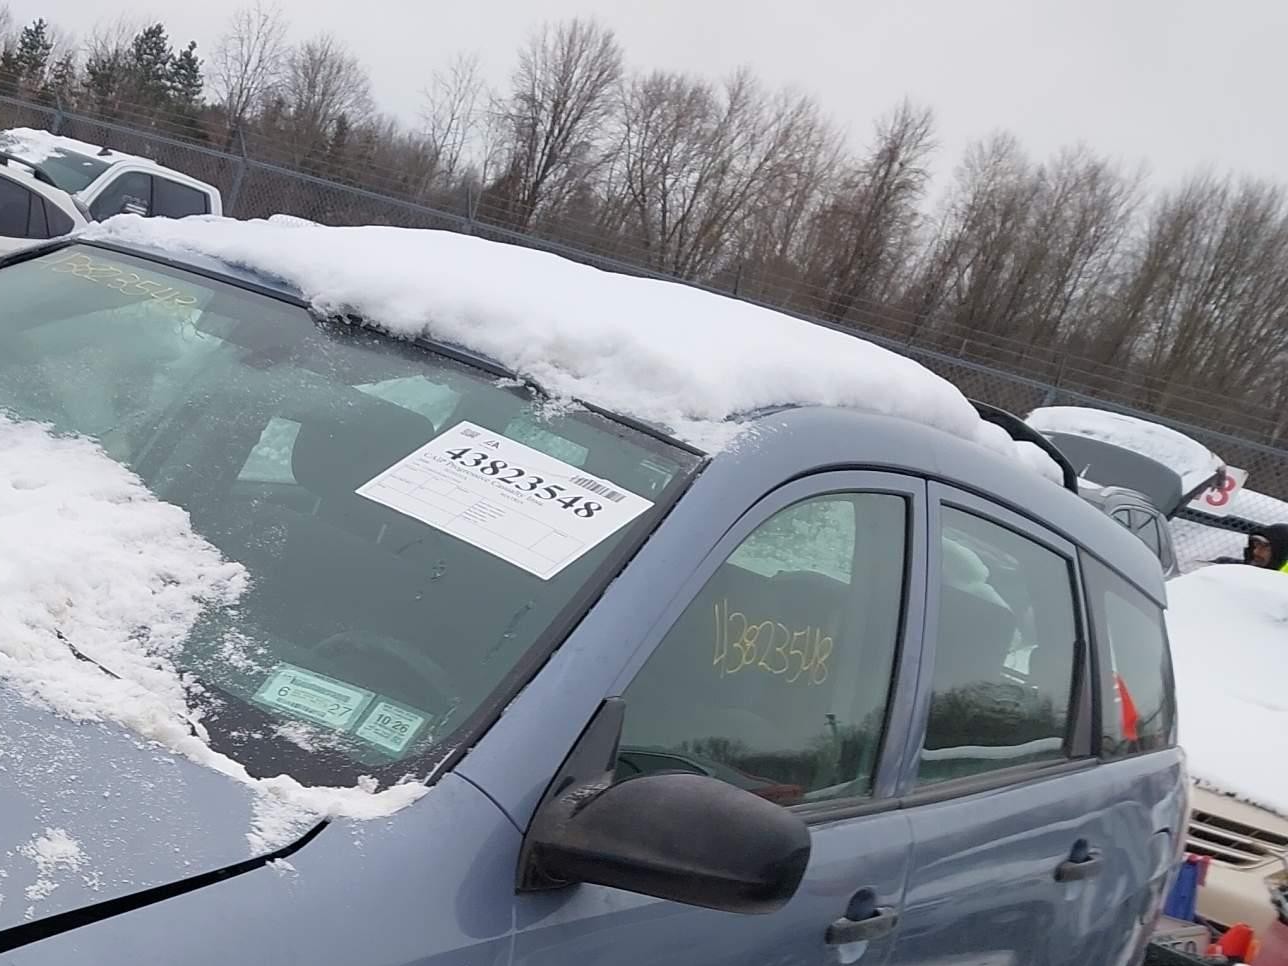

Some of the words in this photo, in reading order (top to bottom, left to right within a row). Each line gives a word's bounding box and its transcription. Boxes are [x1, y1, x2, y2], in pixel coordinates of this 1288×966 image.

[445, 447, 602, 518] 43823548
[278, 686, 290, 697] 6
[327, 703, 353, 716] 27
